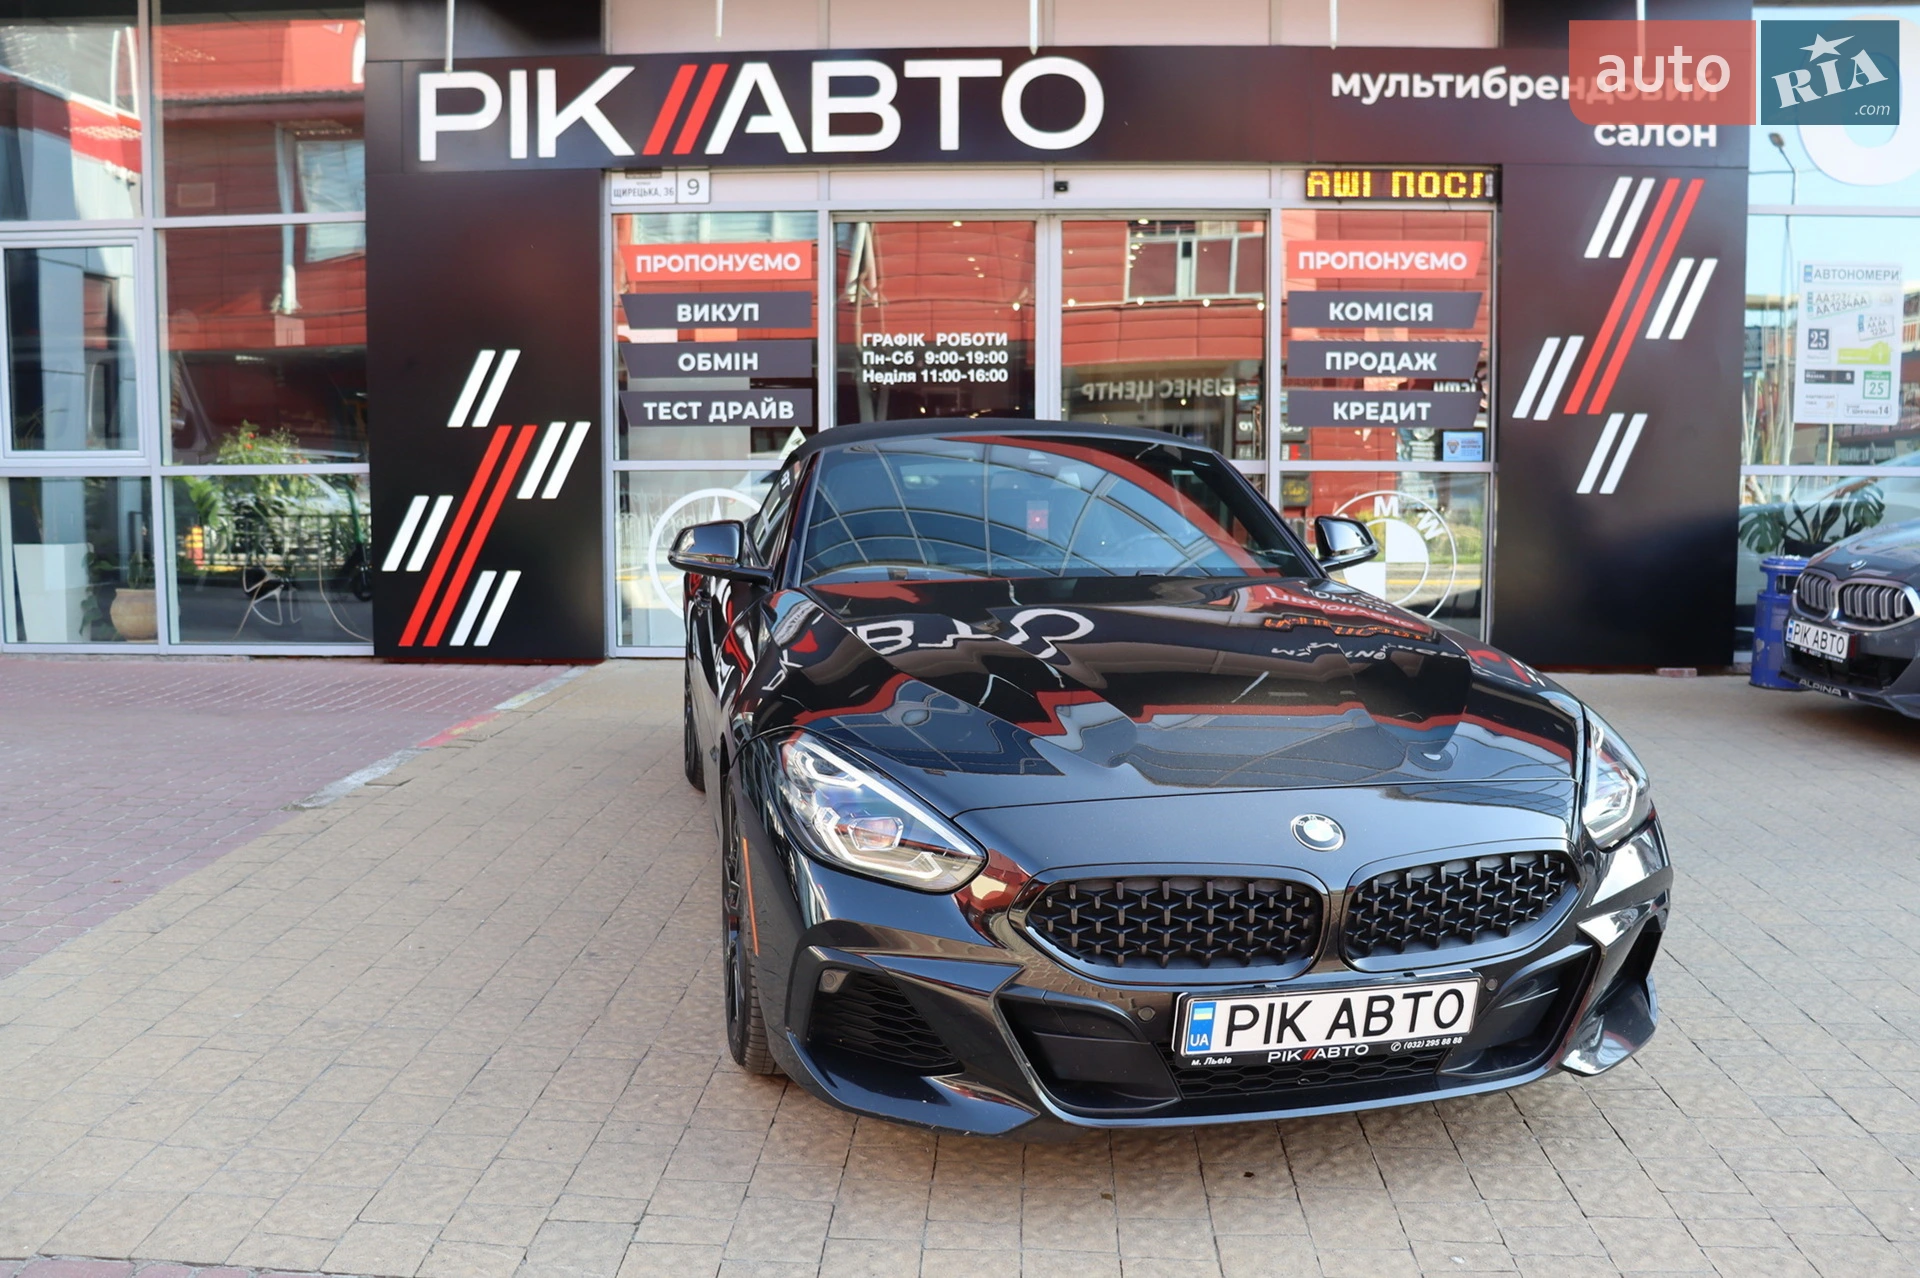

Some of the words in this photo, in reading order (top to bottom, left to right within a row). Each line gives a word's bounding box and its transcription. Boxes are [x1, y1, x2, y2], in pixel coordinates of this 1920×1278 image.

[1594, 122, 1718, 148] салон
[687, 178, 701, 196] 9
[635, 252, 802, 275] ПРОПОНУЄМО
[1298, 250, 1468, 271] ПРОПОНУЄМО
[1813, 268, 1900, 281] АВТОНОМЕРИ
[676, 302, 760, 323] ВИКУП
[1329, 301, 1434, 323] КОМІСІЯ
[862, 333, 925, 347] ГРАФІК
[936, 332, 1008, 346] РОБОТИ
[1809, 330, 1827, 349] 25
[677, 352, 760, 373] ОБМІН
[862, 350, 914, 365] Пн-Сб
[924, 350, 1008, 364] 9:00-19:00
[1325, 351, 1437, 375] ПРОДАЖ
[862, 369, 916, 385] Неділя
[921, 368, 1008, 383] 11:00-16:00
[1868, 382, 1885, 396] 25
[643, 401, 703, 421] ТЕСТ
[708, 396, 795, 423] ДРАЙВ
[1332, 401, 1432, 424] КРЕДИТ
[1799, 679, 1842, 696] ALPINA
[1190, 1033, 1209, 1047] UA
[1403, 1040, 1425, 1049] (032)
[1425, 1038, 1440, 1047] 295
[1441, 1037, 1451, 1045] 88
[1452, 1036, 1463, 1044] 88
